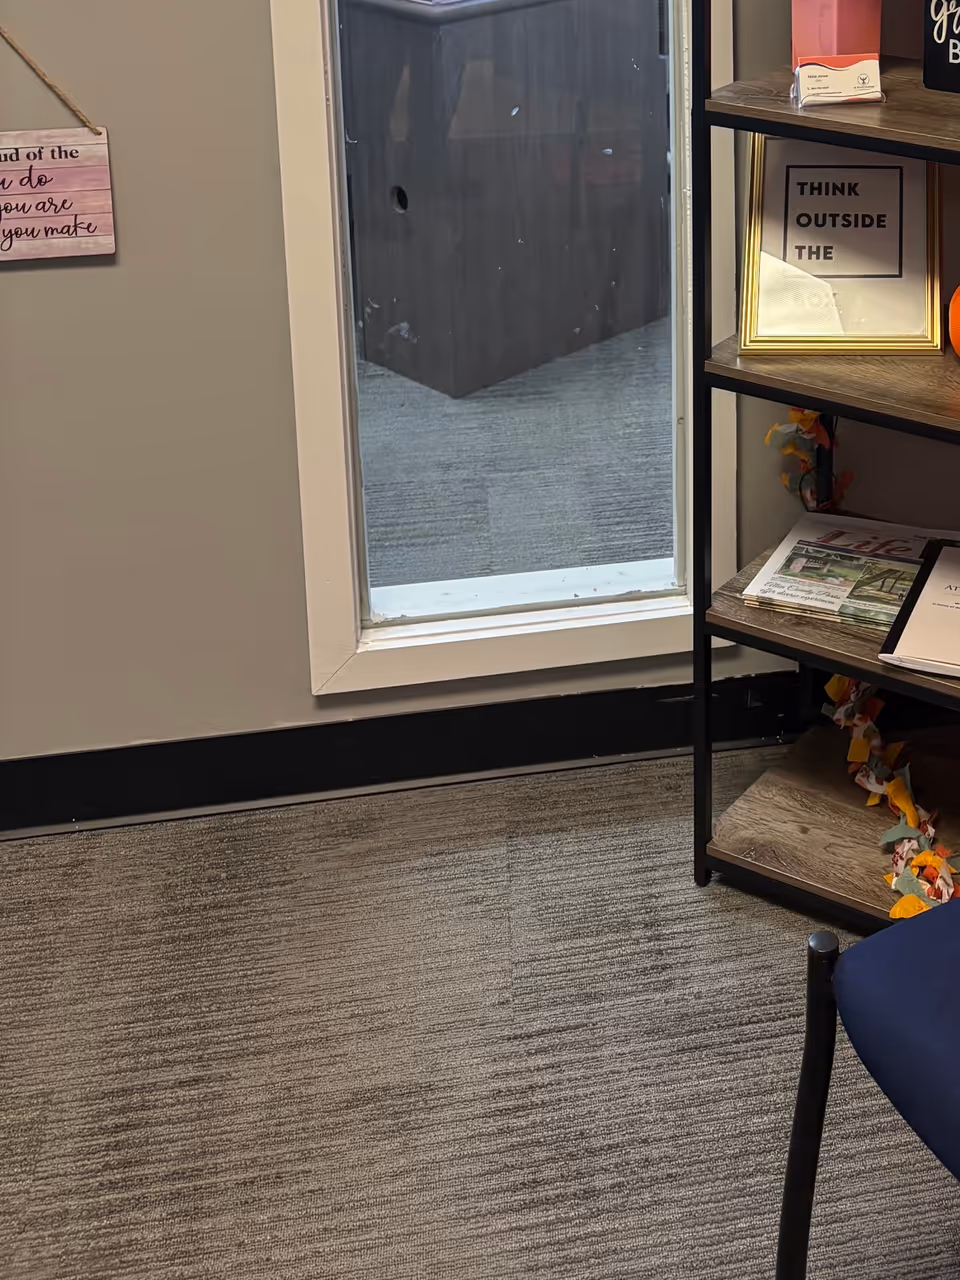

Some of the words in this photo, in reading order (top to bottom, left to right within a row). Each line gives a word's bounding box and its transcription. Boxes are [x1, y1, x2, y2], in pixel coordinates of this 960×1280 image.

[26, 146, 44, 161] of
[50, 145, 80, 160] the
[19, 164, 53, 189] do
[797, 182, 860, 196] THINK
[35, 197, 74, 214] are
[795, 212, 887, 229] OUTSIDE
[0, 226, 40, 252] you
[44, 214, 98, 237] make
[794, 245, 834, 261] THE
[816, 529, 913, 556] Life
